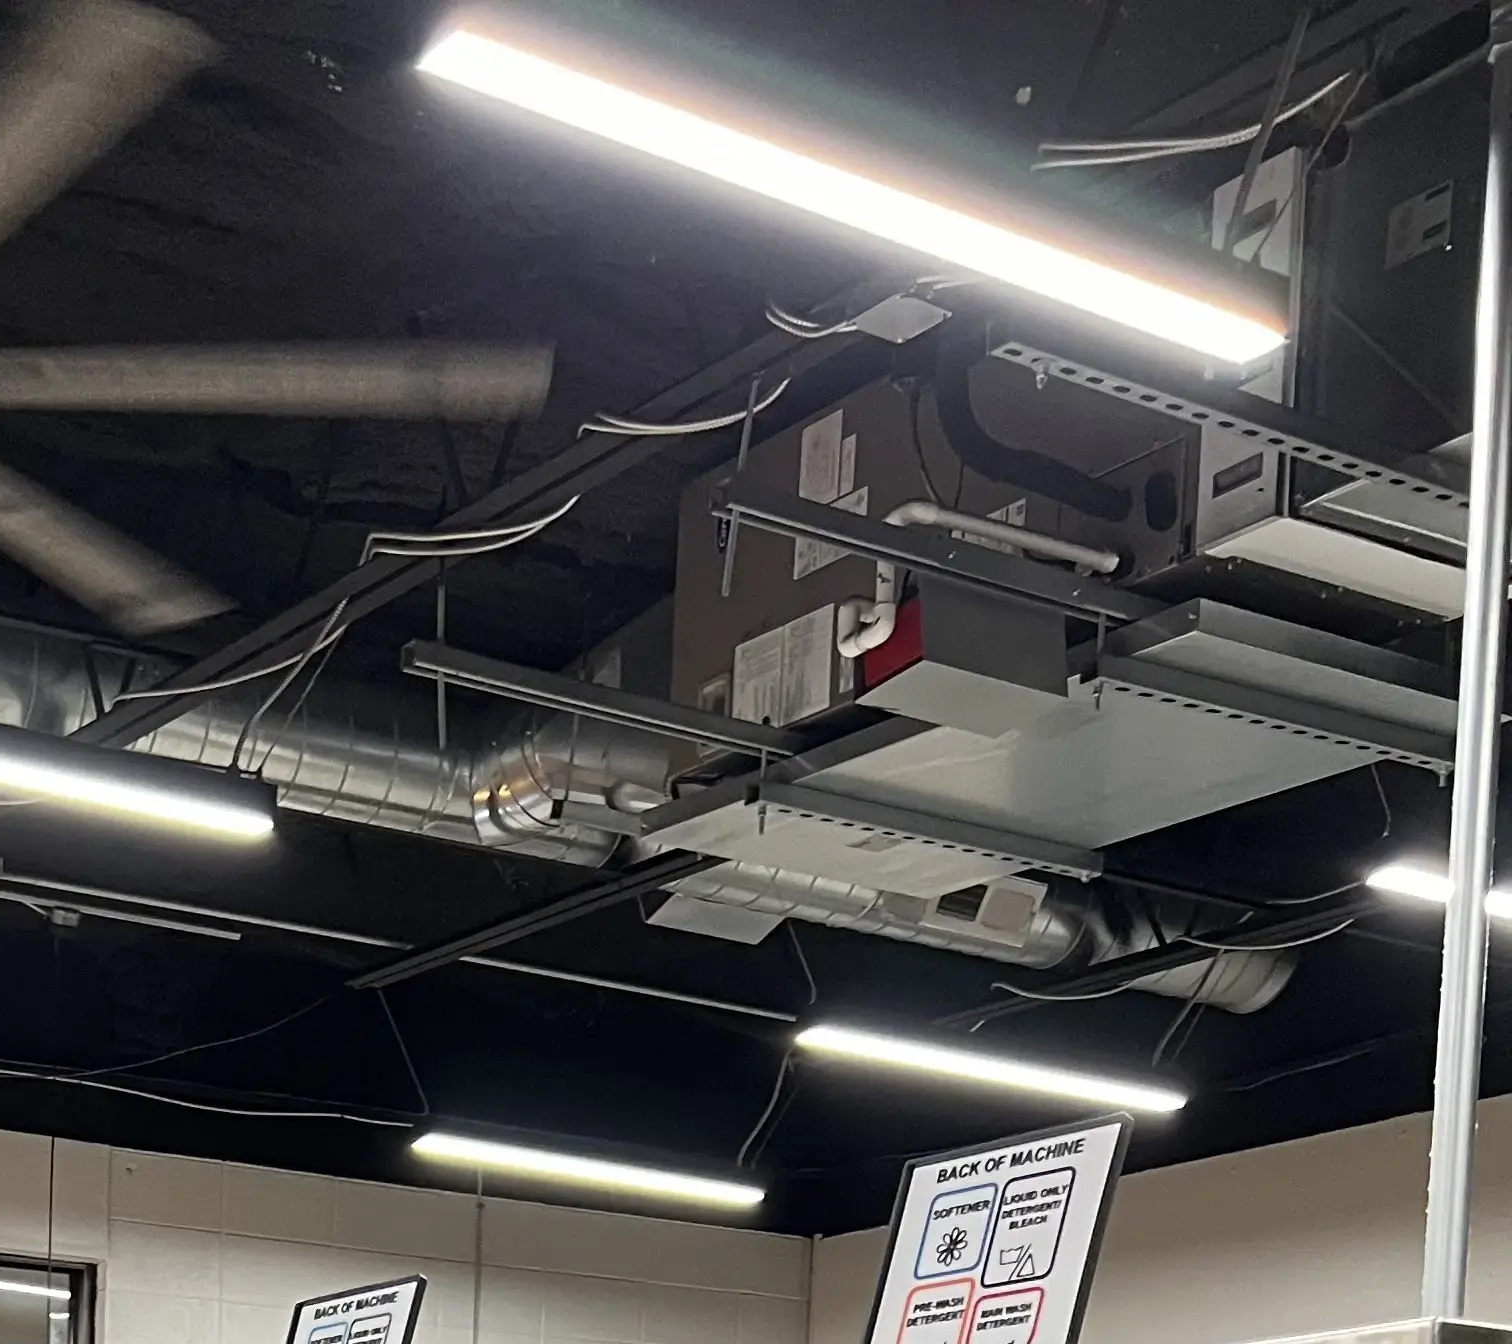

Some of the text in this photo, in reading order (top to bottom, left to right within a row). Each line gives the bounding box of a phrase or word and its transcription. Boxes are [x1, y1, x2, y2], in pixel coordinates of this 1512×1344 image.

[937, 1138, 1086, 1184] BACK OF MACHINE
[933, 1200, 990, 1220] SOFTENER
[1008, 1215, 1048, 1230] BLEACH
[341, 1301, 354, 1314] OF
